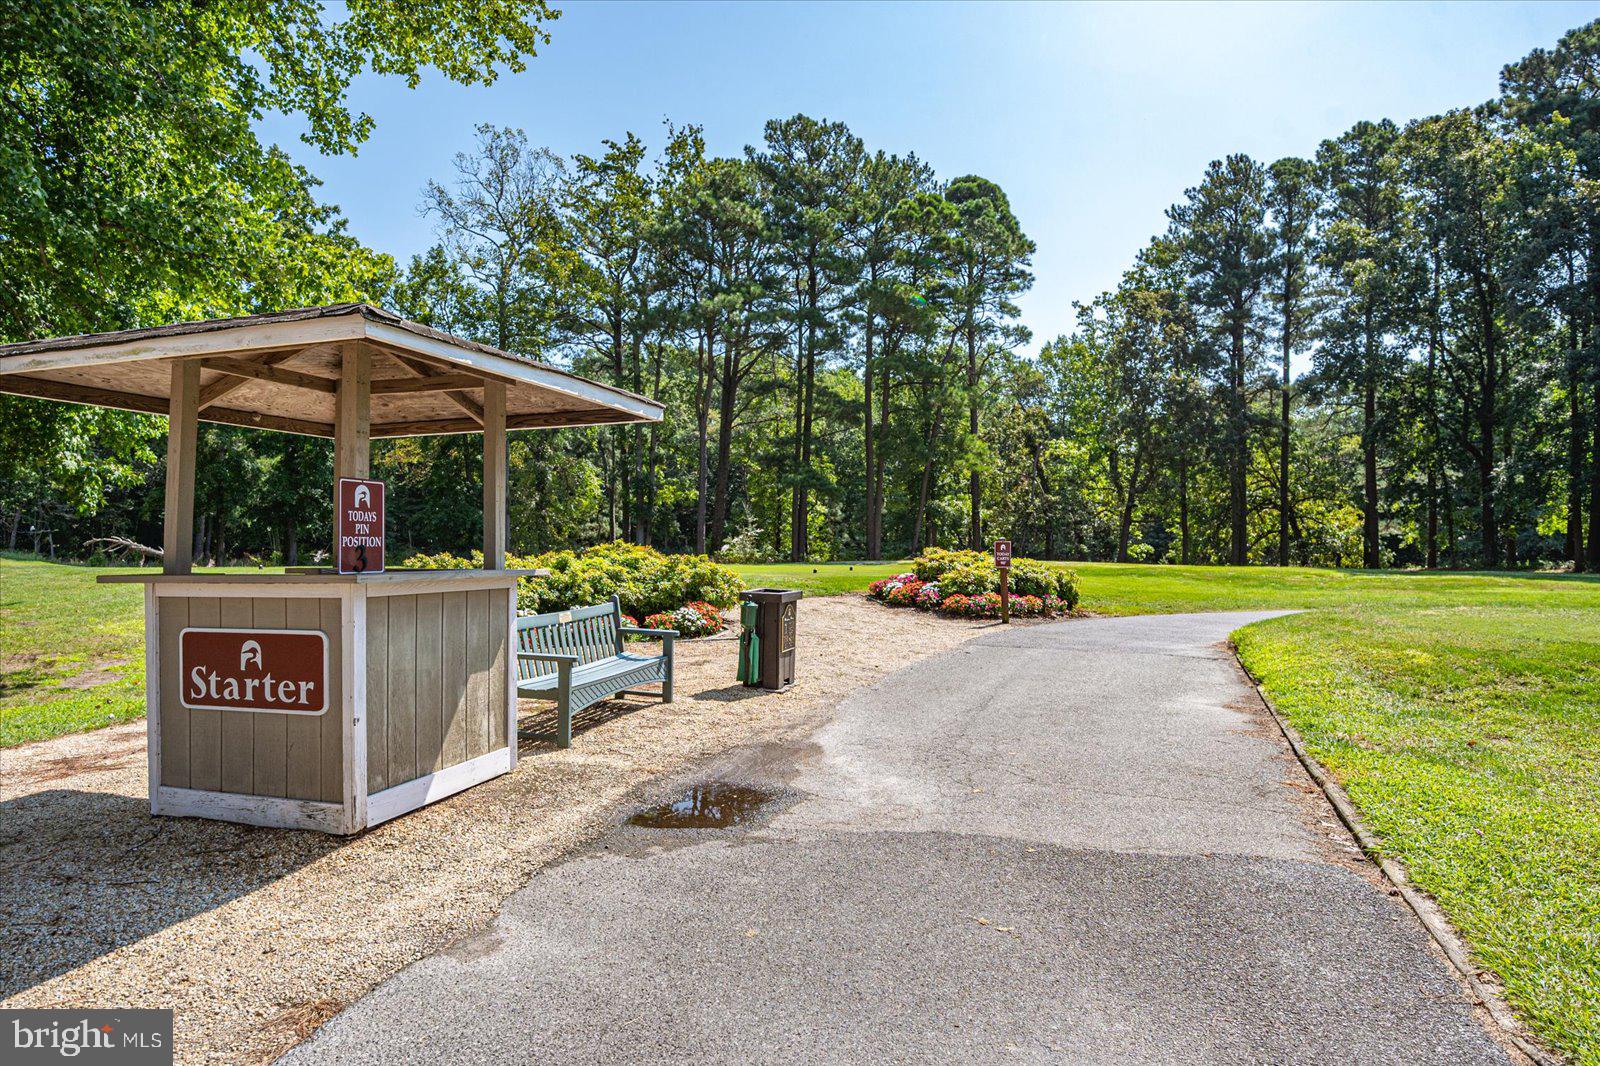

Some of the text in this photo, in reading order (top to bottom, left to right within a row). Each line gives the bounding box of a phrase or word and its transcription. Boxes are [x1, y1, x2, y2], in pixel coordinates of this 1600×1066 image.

[348, 510, 377, 523] TODAYS
[355, 523, 369, 535] PIN
[342, 536, 382, 547] POSITION
[353, 544, 367, 572] 3
[190, 665, 315, 705] Starter
